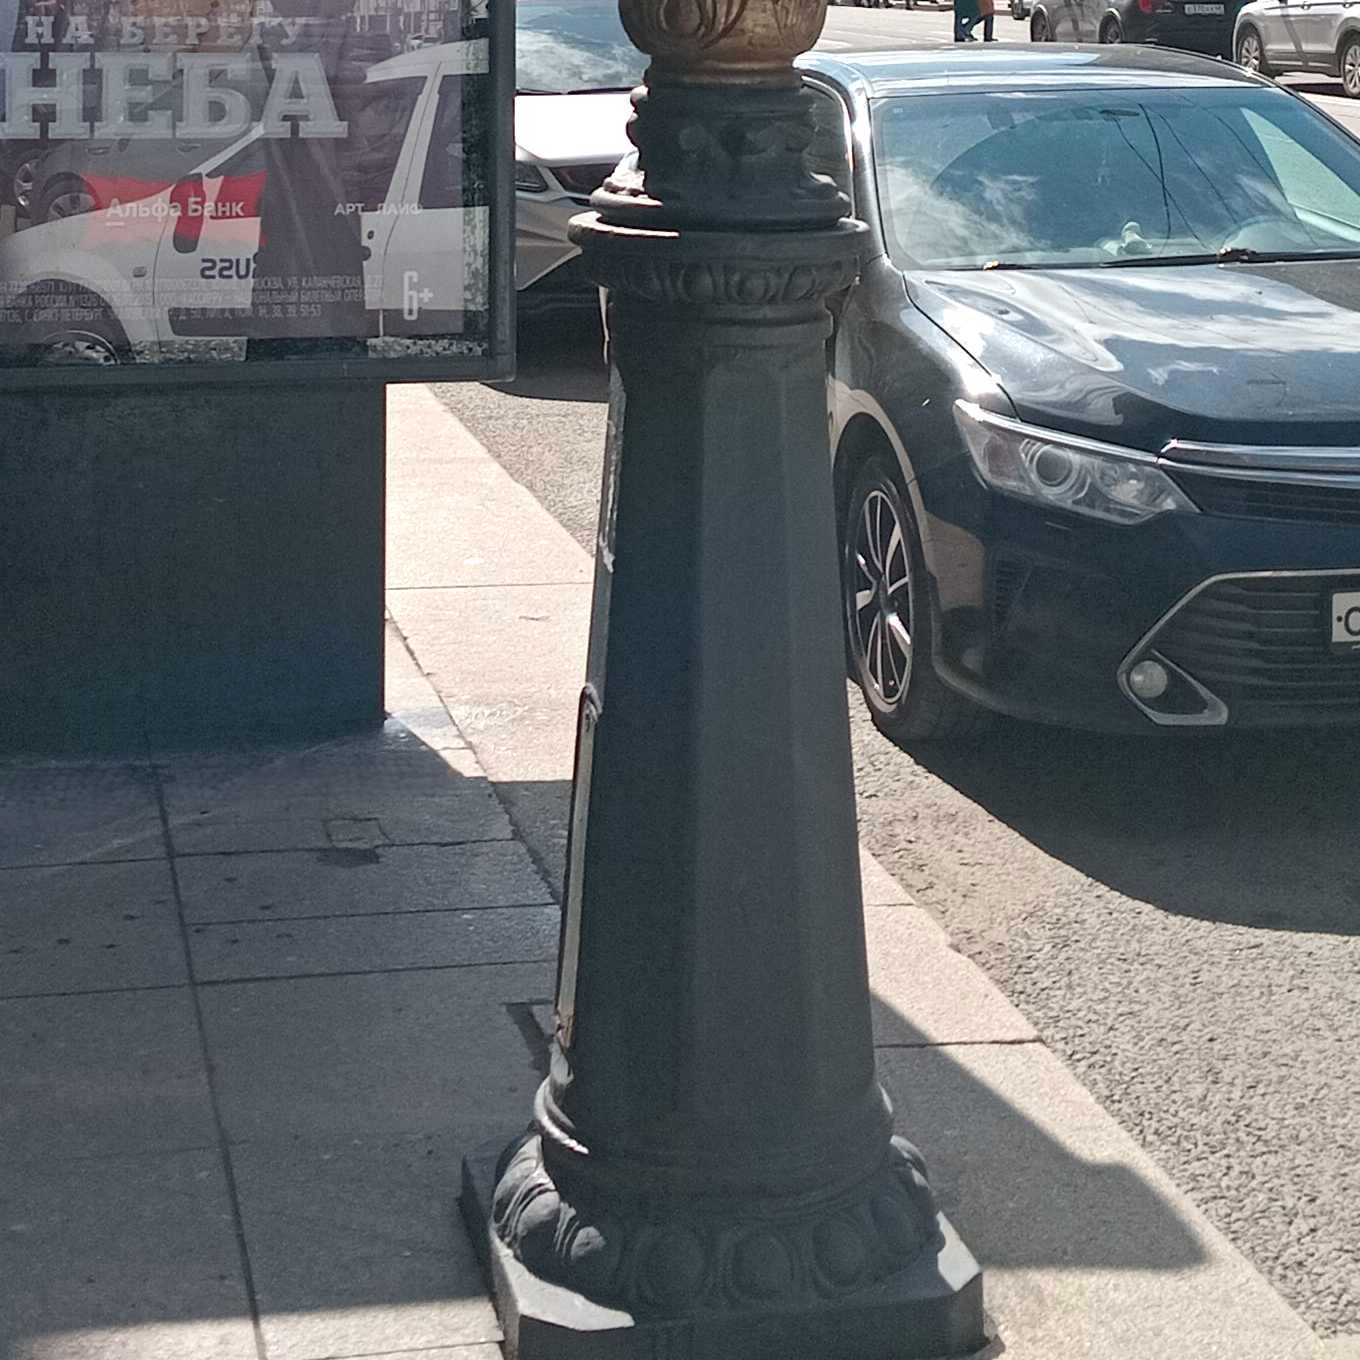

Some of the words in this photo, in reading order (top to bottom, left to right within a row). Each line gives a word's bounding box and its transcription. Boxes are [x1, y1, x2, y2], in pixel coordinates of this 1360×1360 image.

[25, 15, 94, 45] НА
[119, 14, 309, 46] БЕРЕГУ
[105, 197, 181, 222] Альфа
[188, 196, 245, 217] Банк
[402, 271, 433, 321] 6+
